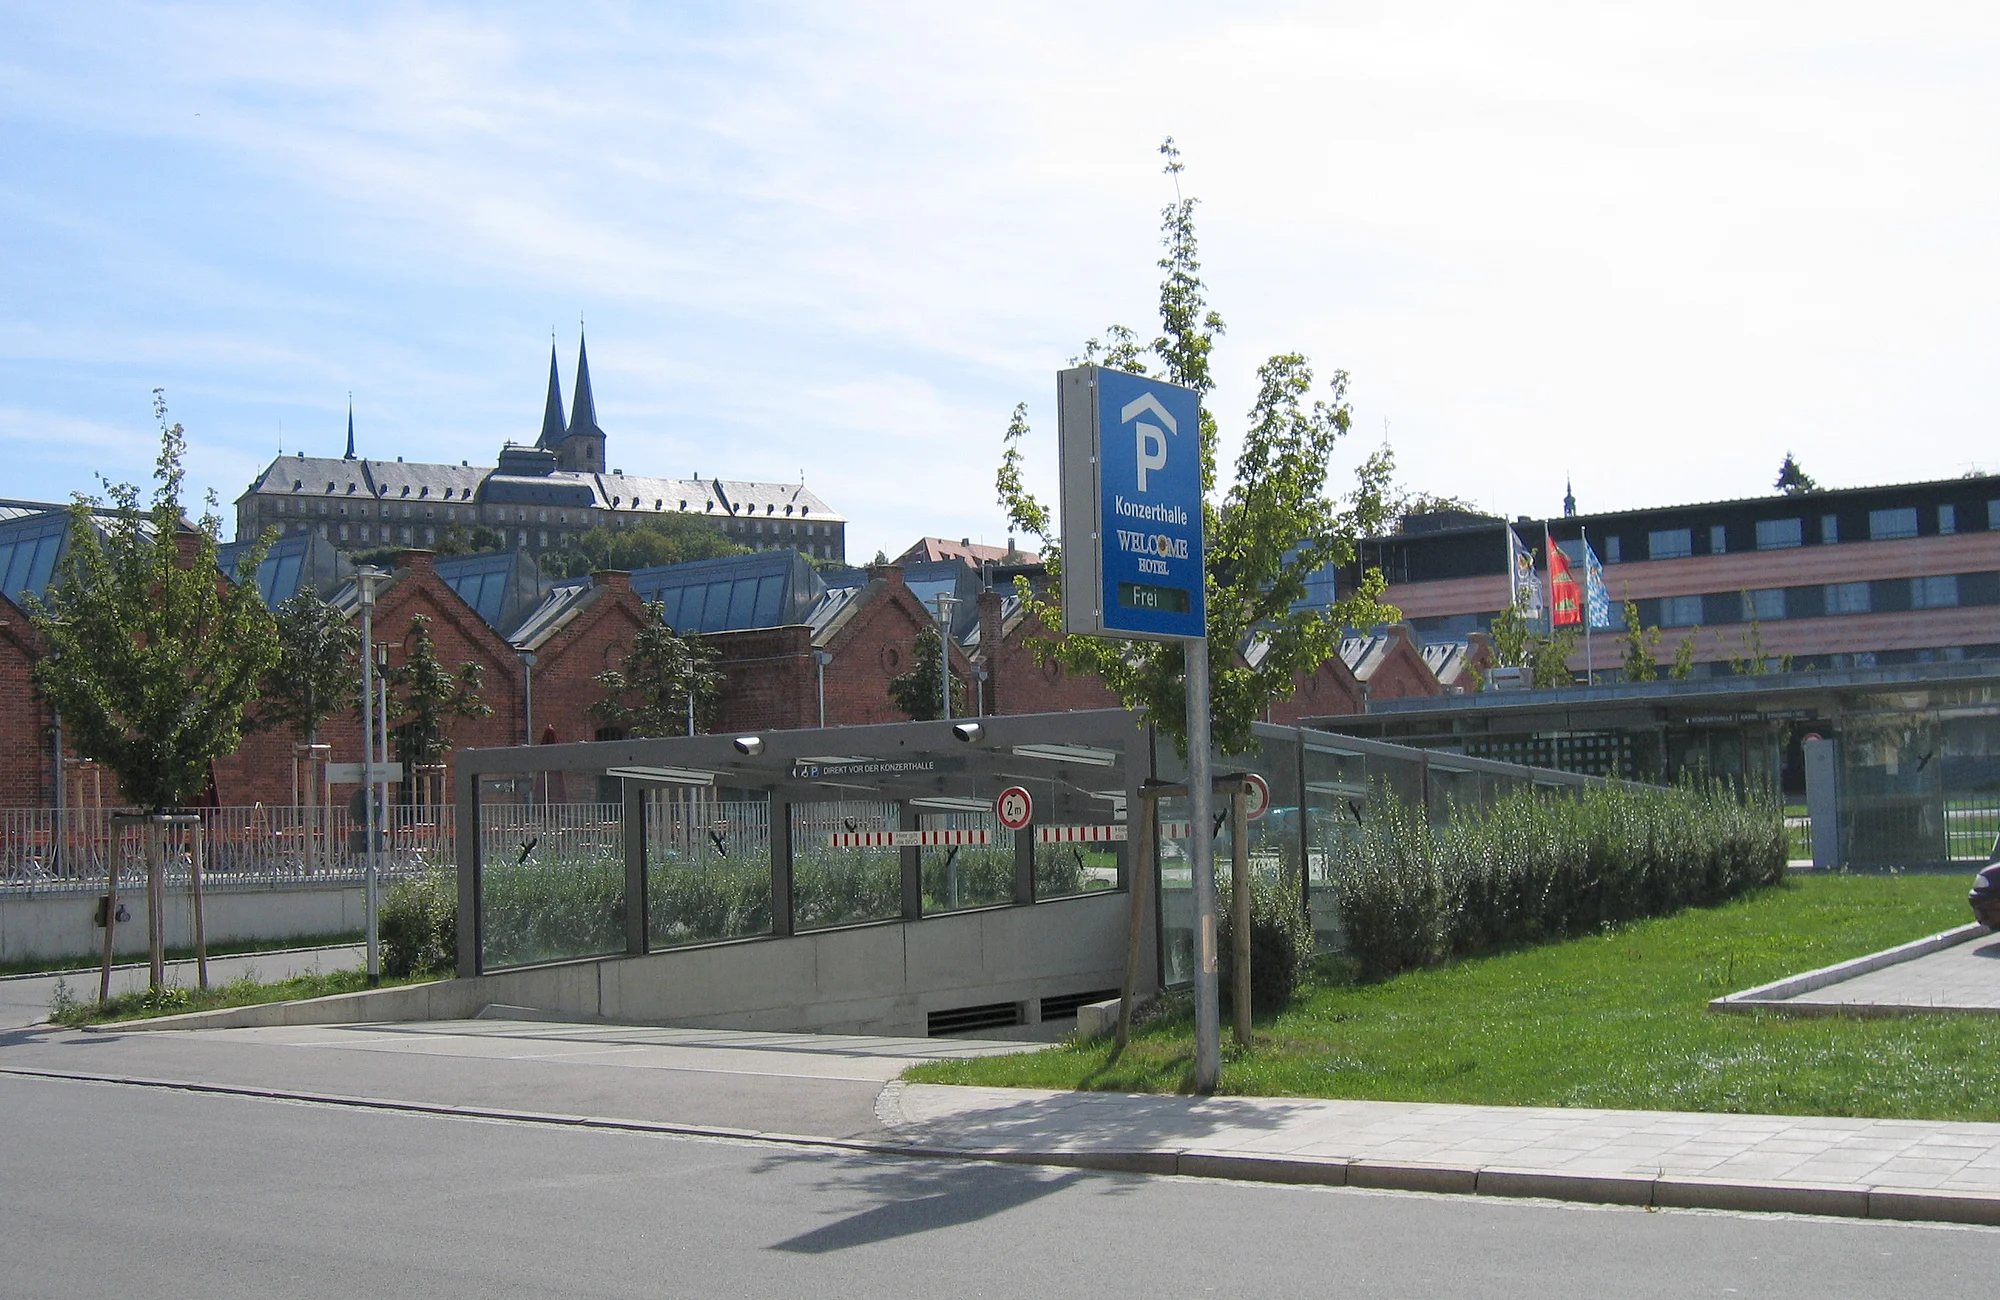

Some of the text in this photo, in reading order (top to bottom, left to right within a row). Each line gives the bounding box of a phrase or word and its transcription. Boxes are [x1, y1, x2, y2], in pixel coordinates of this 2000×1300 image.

[1136, 421, 1168, 492] P
[1115, 495, 1187, 525] Konzerthalle
[1117, 529, 1188, 559] WELCOME
[1138, 557, 1169, 575] HOTEL
[1133, 585, 1158, 607] Frei
[823, 766, 847, 775] DIREKT
[849, 765, 863, 773] VOR
[865, 764, 879, 773] DER
[880, 761, 934, 772] KONZERTHALLE
[1007, 801, 1022, 815] 2 m
